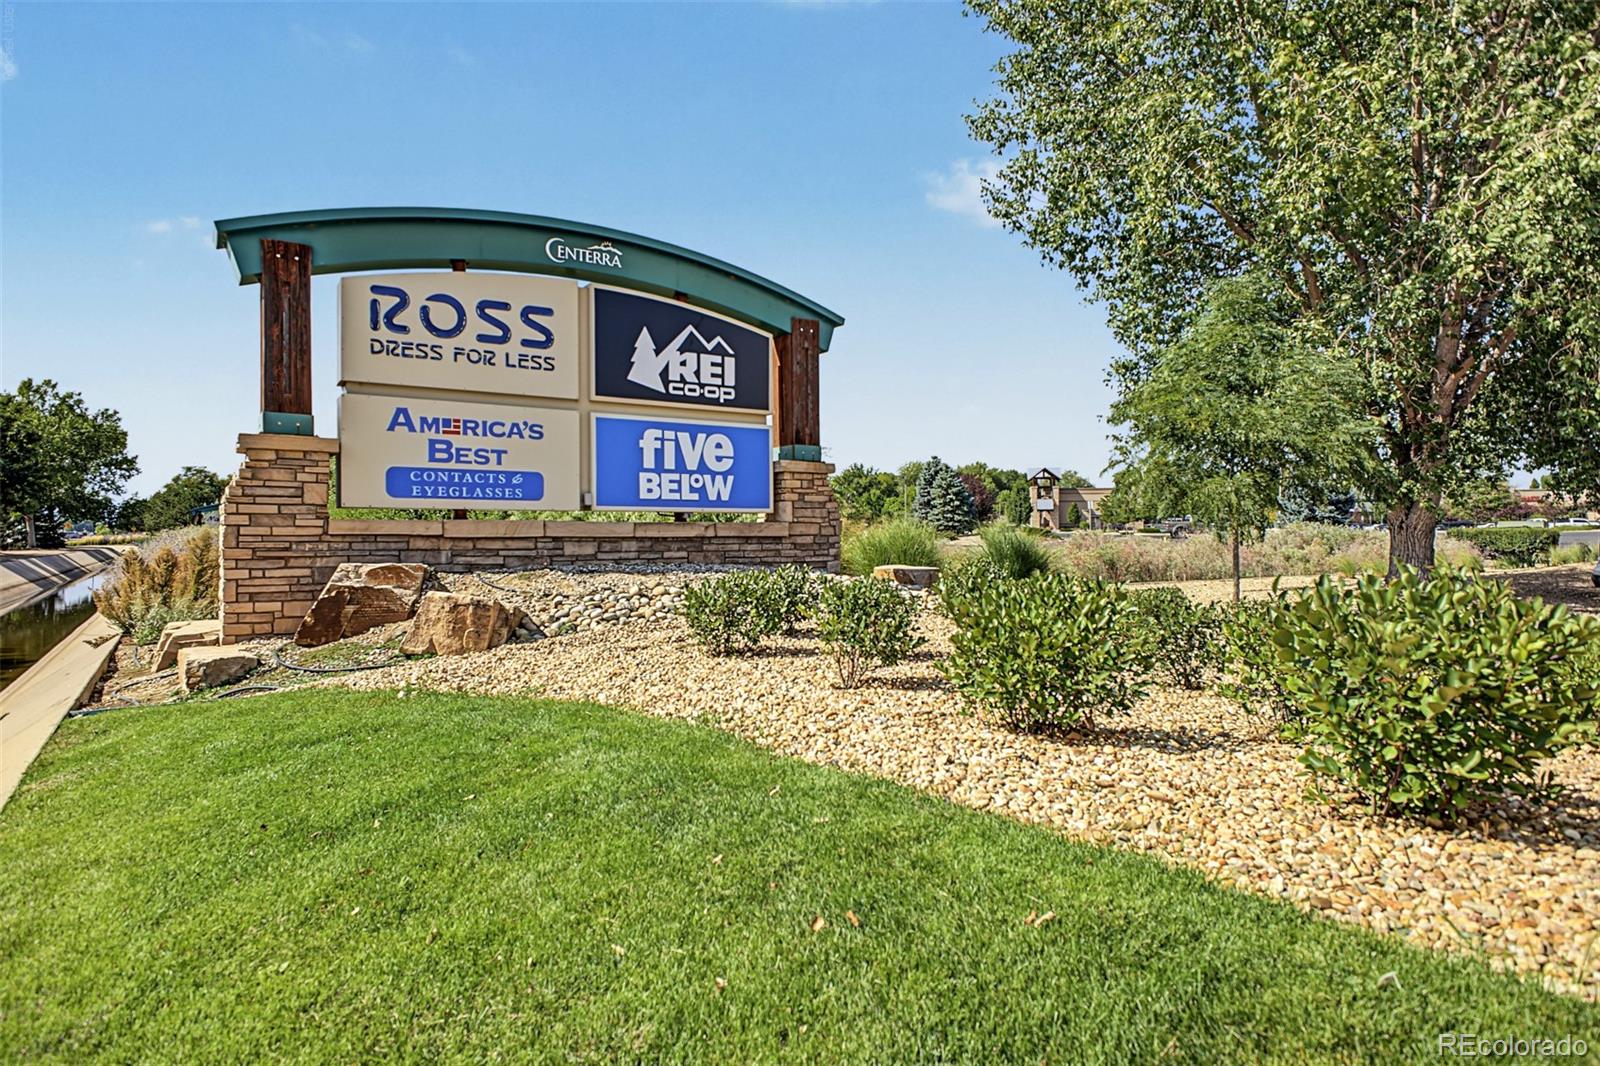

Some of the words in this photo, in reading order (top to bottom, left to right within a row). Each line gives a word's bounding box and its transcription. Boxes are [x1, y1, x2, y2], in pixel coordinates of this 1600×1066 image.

[369, 284, 555, 349] ROSS
[370, 339, 443, 361] DRESS
[453, 347, 496, 367] FOR
[505, 352, 556, 371] LESS
[669, 351, 736, 386] REI
[386, 407, 544, 440] AMERICA'S
[428, 438, 508, 466] BEST
[410, 470, 506, 484] CONTACTS
[512, 473, 524, 485] &
[412, 484, 524, 499] EYEGLASSES
